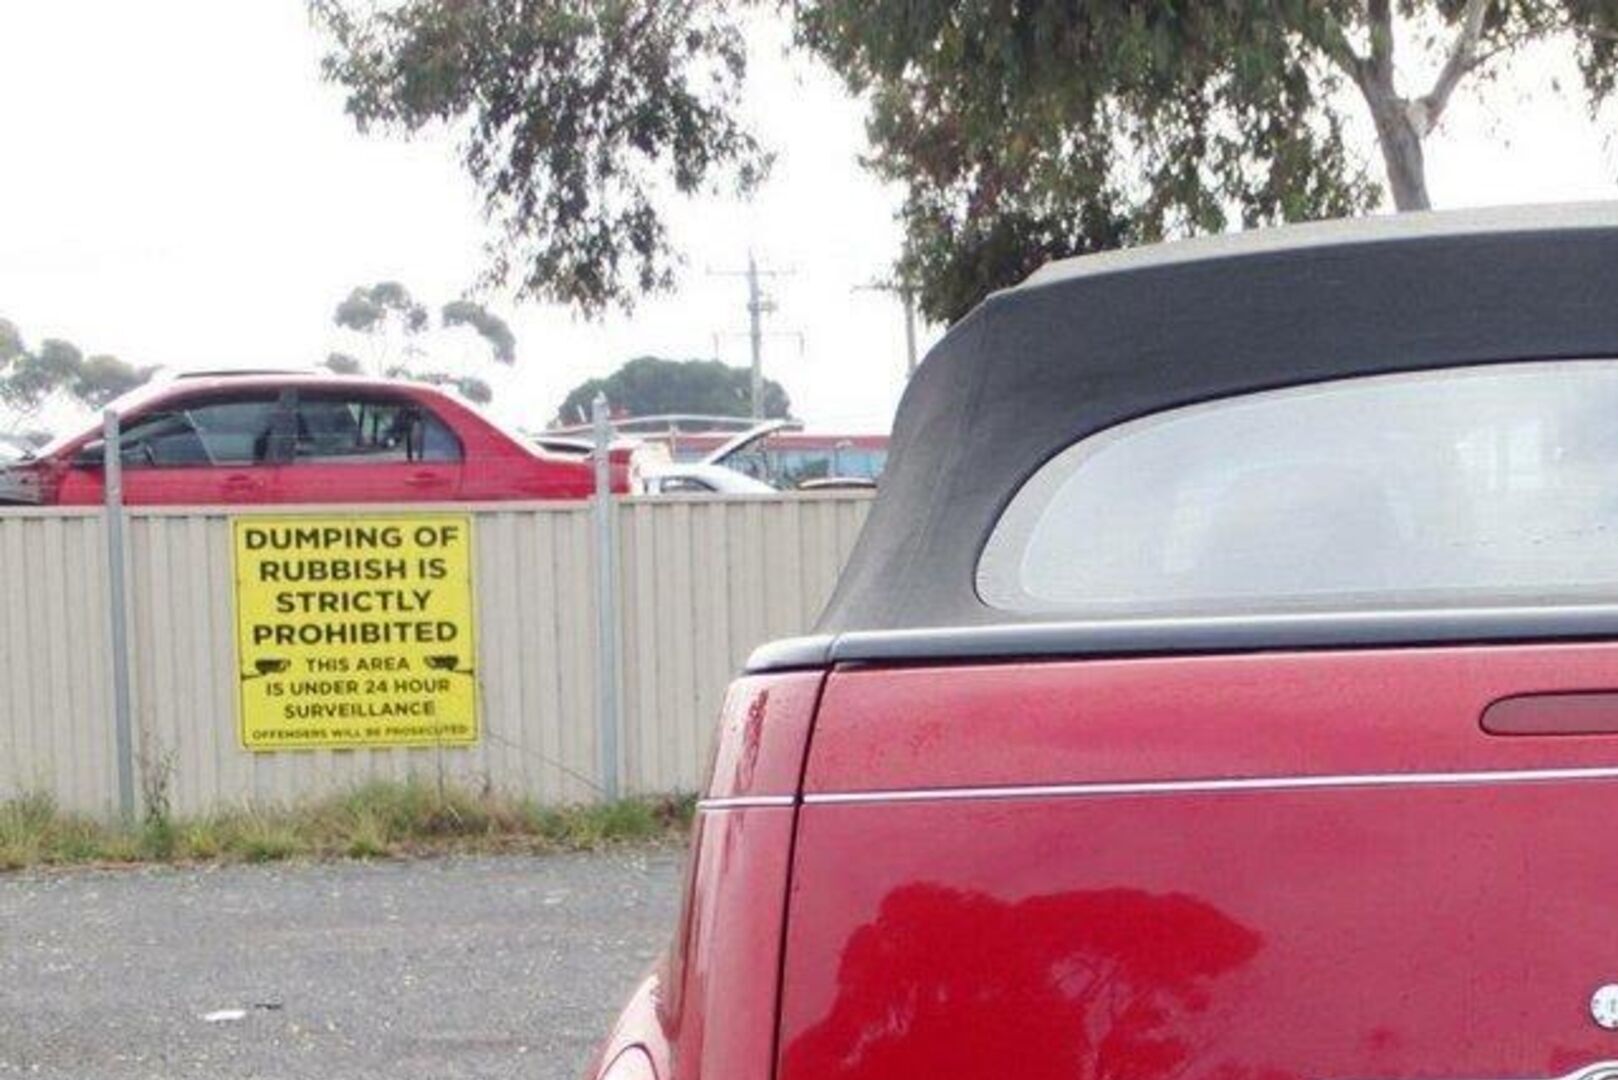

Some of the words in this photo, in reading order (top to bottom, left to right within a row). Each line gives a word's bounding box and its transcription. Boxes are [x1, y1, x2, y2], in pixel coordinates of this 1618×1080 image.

[245, 527, 403, 550] DUMPING
[414, 526, 459, 548] OF
[260, 559, 407, 581] RUBBISH
[419, 558, 447, 579] IS
[276, 590, 432, 613] STRICTLY
[253, 622, 458, 645] PROHIBITED
[306, 658, 349, 673] THIS
[356, 657, 410, 672] AREA
[266, 683, 284, 697] IS
[290, 681, 358, 696] UNDER
[365, 680, 388, 693] 24
[394, 679, 450, 693] HOUR
[284, 701, 436, 719] SURVEILLANCE
[253, 729, 327, 740] OFFENDERS
[332, 728, 363, 738] WILL
[366, 727, 381, 737] BE
[386, 724, 468, 736] PROSECUTED
